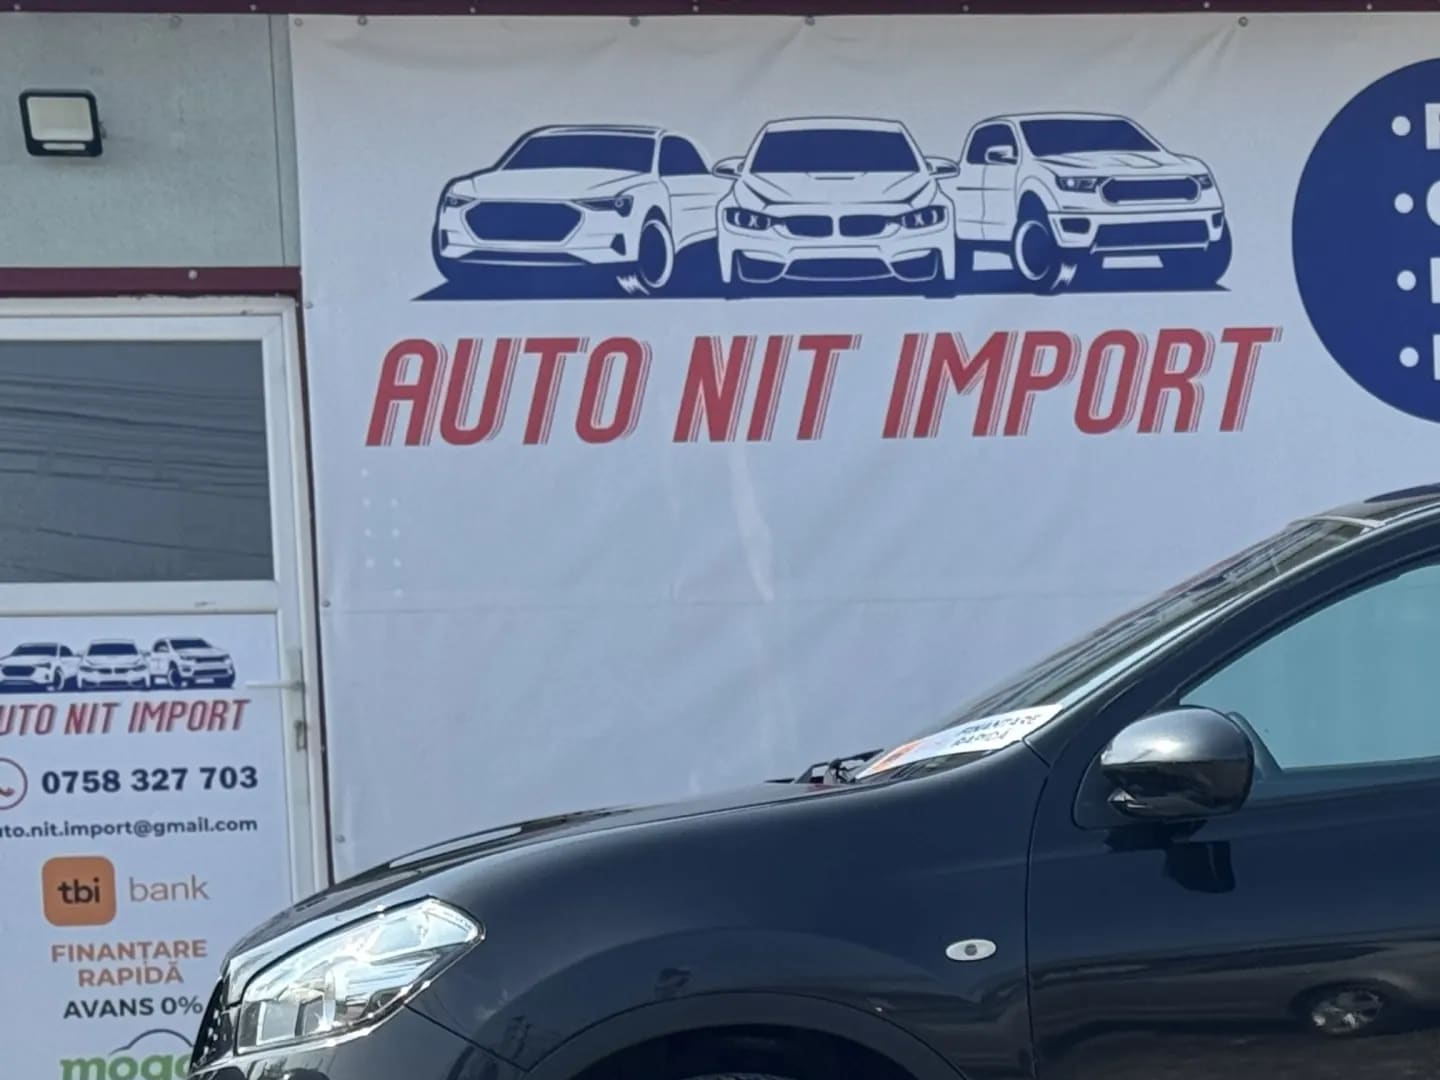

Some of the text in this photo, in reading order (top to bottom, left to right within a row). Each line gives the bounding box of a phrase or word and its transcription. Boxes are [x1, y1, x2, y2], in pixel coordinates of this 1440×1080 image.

[365, 325, 1282, 447] AUTO NIT IMPORT
[64, 702, 121, 735] NIT
[128, 699, 251, 734] IMPORT
[41, 765, 258, 794] 0758 327 703
[57, 875, 210, 905] tbi bank
[63, 995, 204, 1019] AVANS 0%
